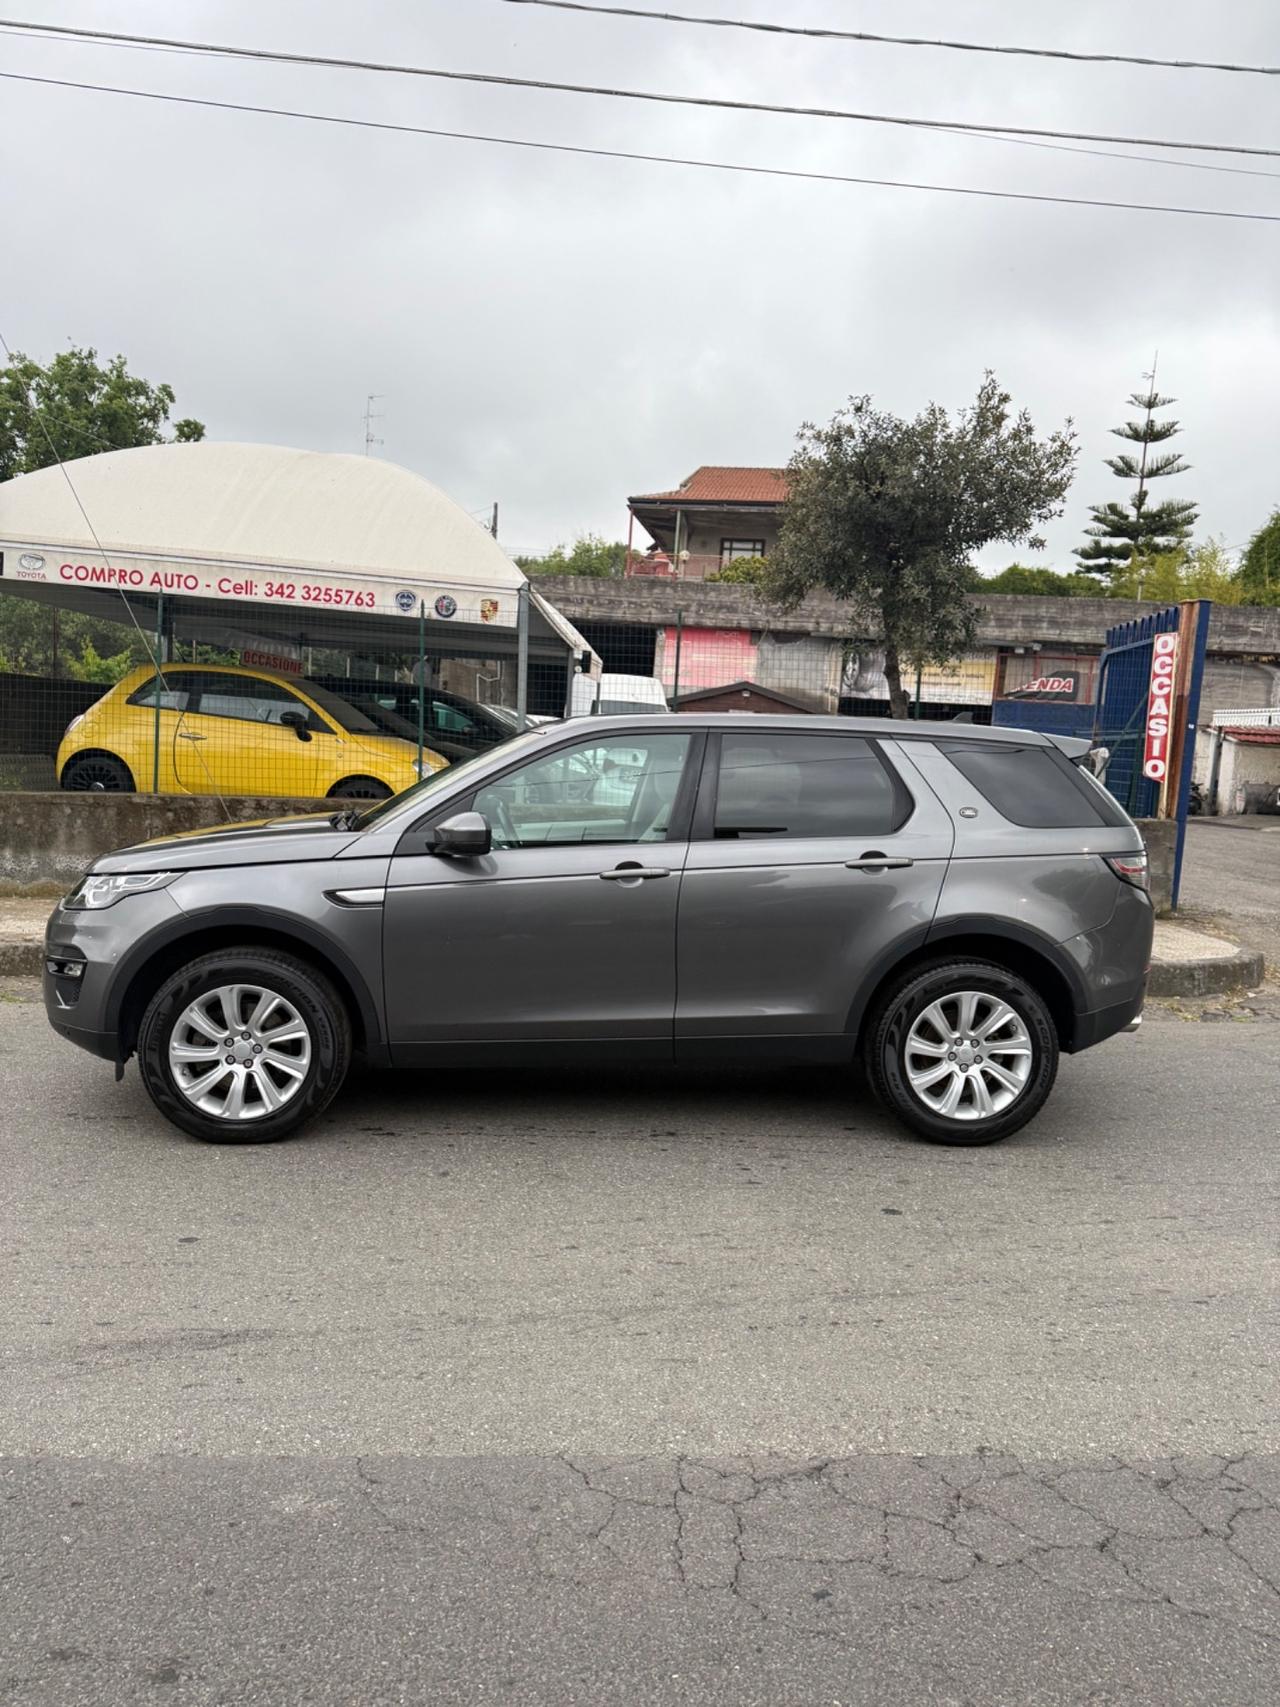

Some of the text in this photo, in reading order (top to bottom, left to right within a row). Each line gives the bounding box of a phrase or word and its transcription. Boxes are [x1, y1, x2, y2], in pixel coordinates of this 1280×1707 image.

[16, 571, 47, 580] TOYOTA
[59, 564, 144, 586] COMPRO
[150, 571, 199, 591] AUTO
[217, 577, 258, 596] Cell:
[264, 581, 296, 600] 342
[301, 585, 376, 608] 3255763
[1144, 635, 1175, 778] OCCASIO
